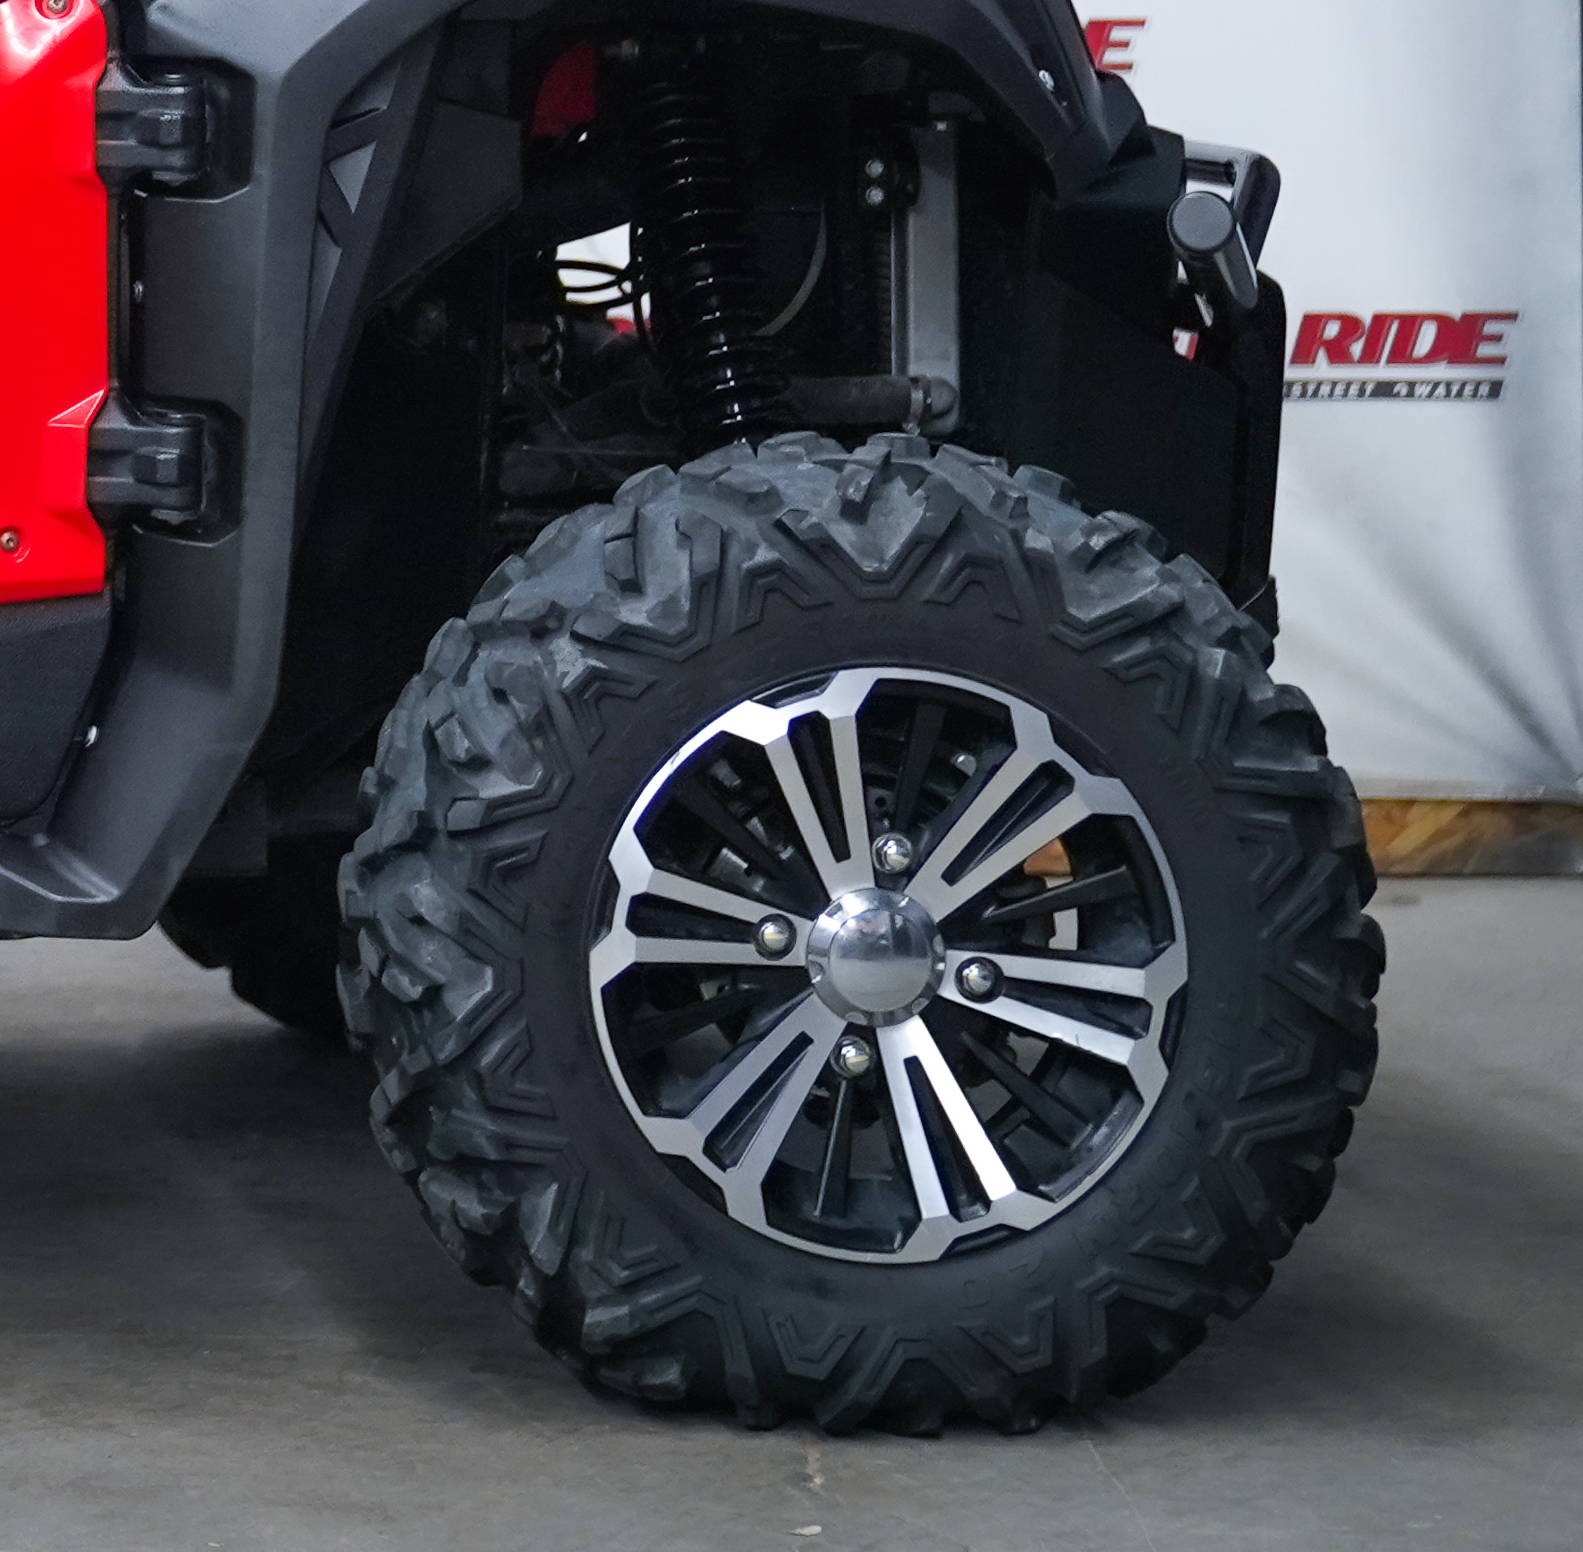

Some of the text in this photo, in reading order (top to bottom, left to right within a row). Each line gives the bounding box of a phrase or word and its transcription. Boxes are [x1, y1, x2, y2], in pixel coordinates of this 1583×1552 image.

[1289, 310, 1519, 365] RIDE
[1290, 380, 1491, 399] STREET WATER
